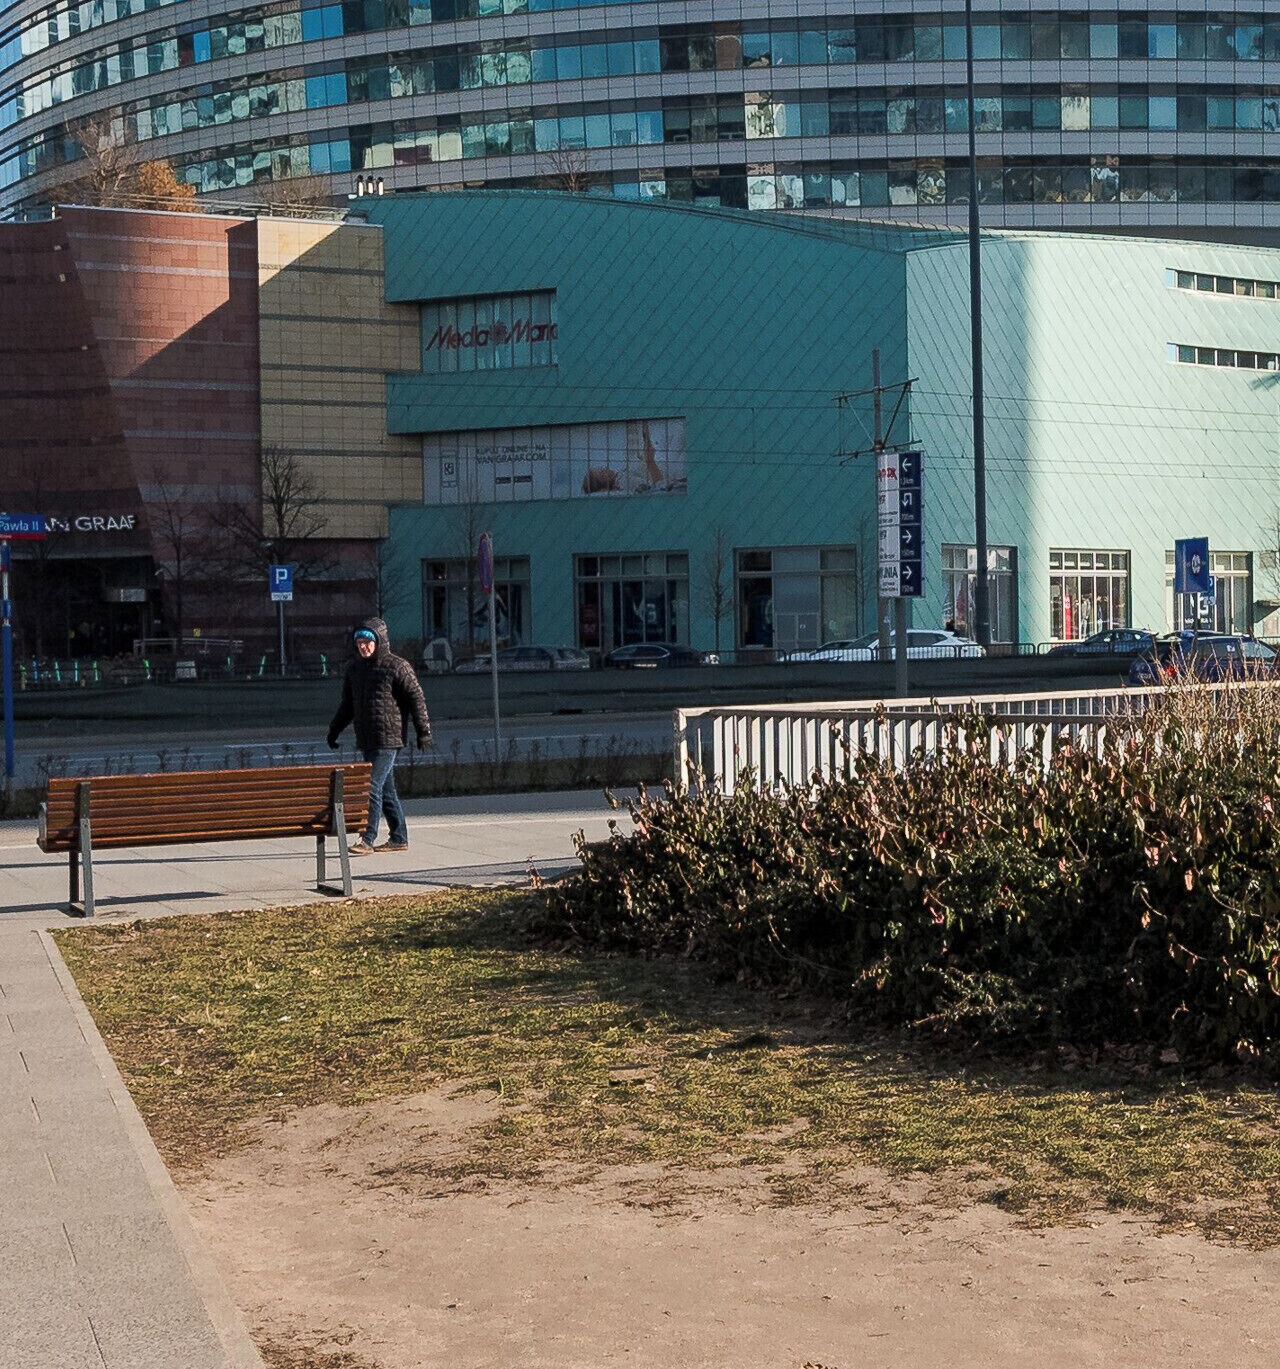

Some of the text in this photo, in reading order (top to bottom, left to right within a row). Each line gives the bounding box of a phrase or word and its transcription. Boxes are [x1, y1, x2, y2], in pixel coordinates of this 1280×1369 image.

[32, 520, 40, 532] II
[75, 514, 137, 533] GRAAF
[275, 568, 288, 585] P
